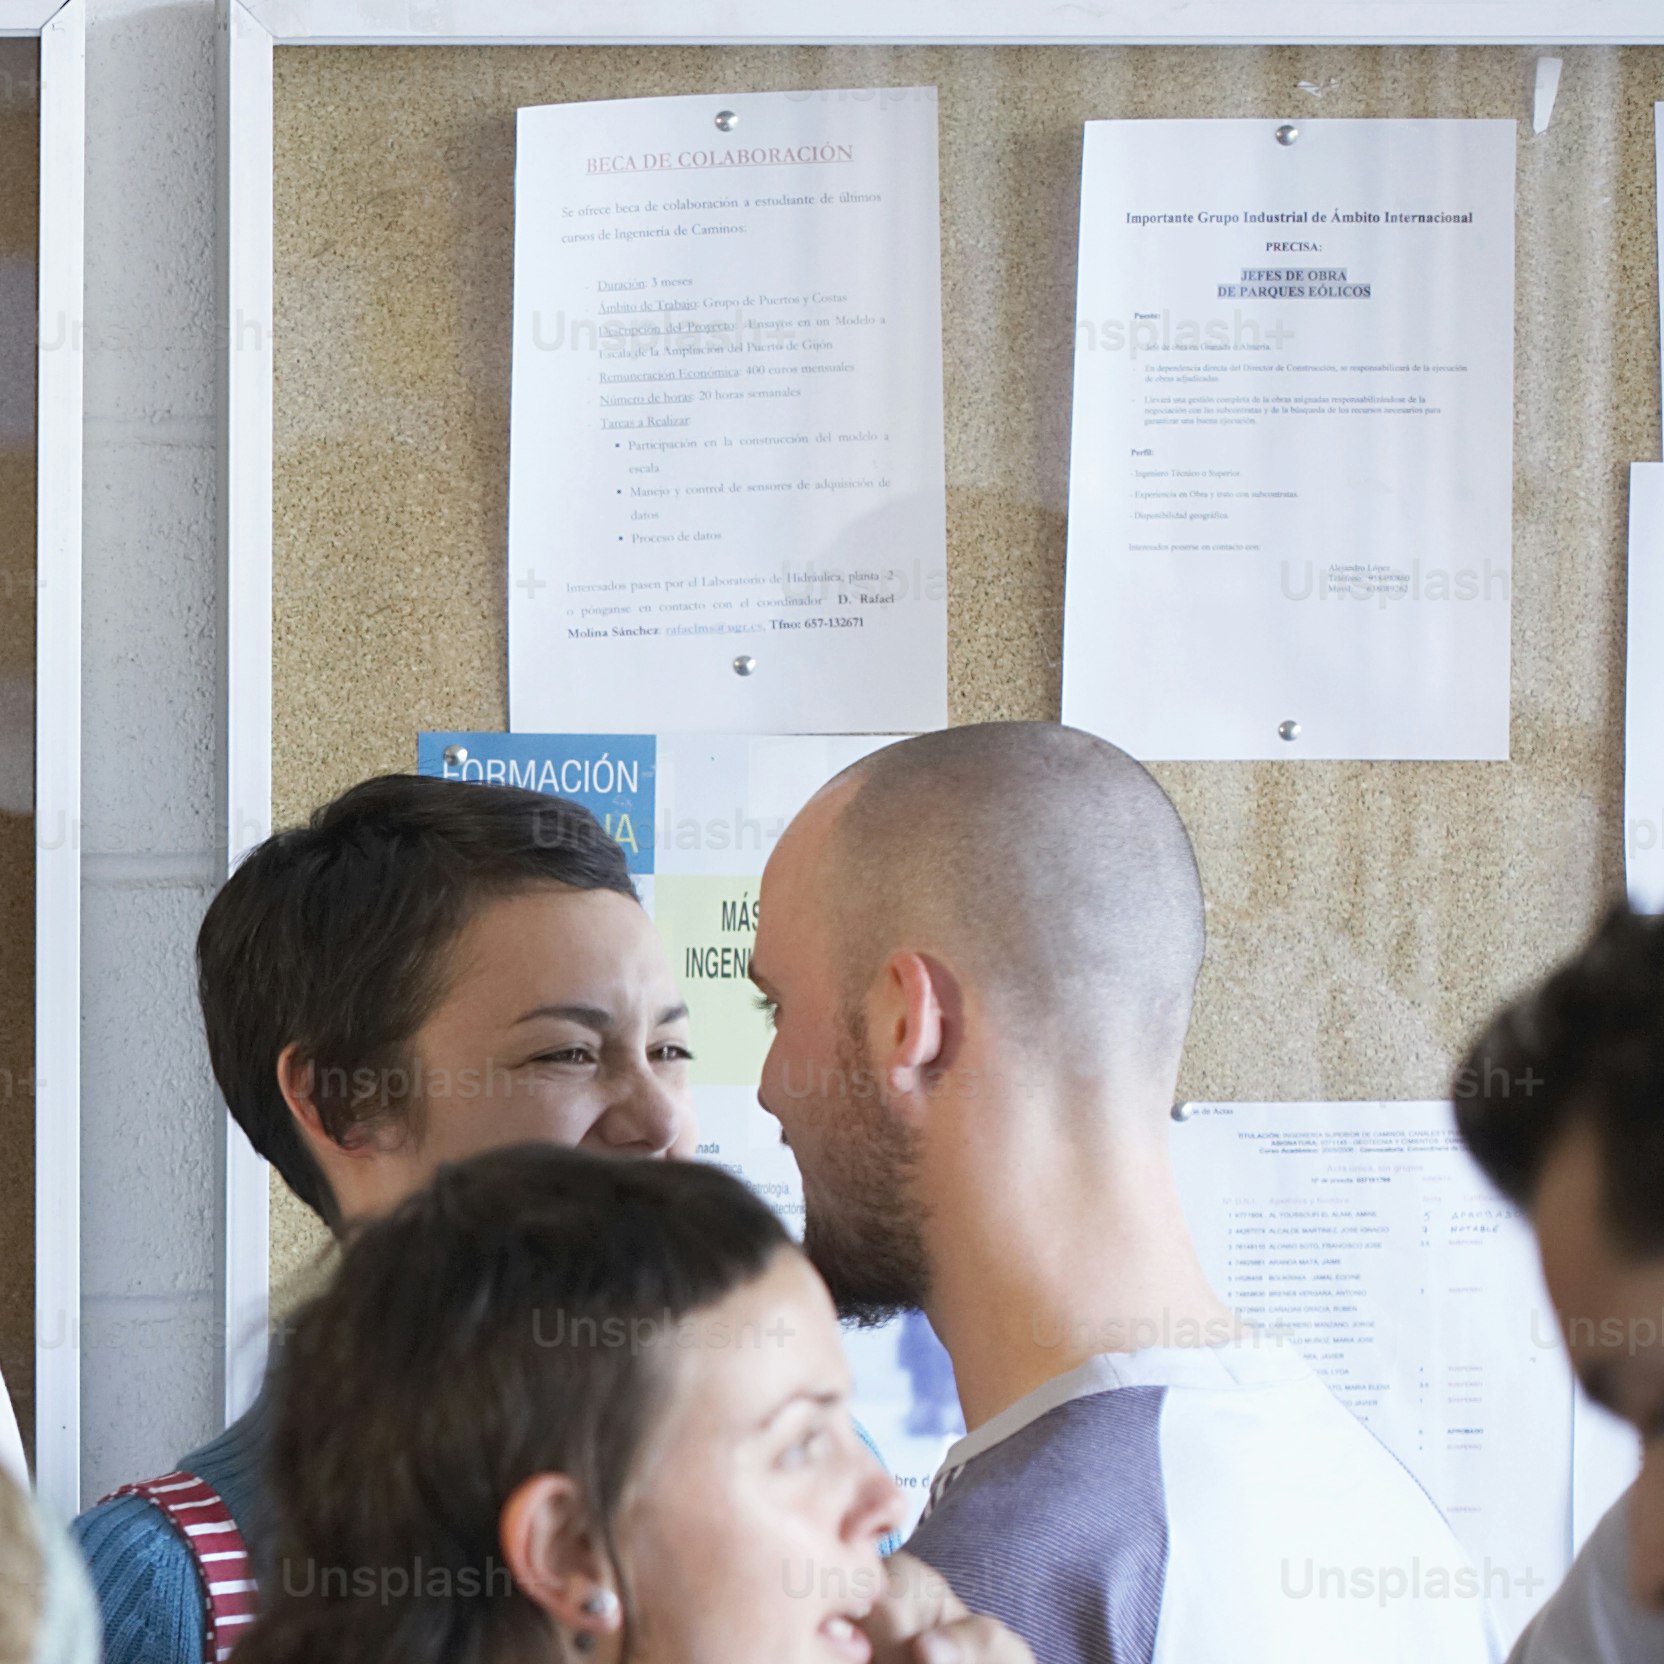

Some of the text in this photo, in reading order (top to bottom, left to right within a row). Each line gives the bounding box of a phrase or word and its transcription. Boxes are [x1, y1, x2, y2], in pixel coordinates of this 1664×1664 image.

[587, 140, 853, 176] BECA DE COLABORACIÓN
[1126, 207, 1473, 227] Importante Grupo Industrial de Ámbito Internacional
[1266, 241, 1322, 252] PRECISA:
[1241, 270, 1347, 282] JEFES DE OBRA
[1217, 283, 1371, 300] DE PARQUES EÓLICOS
[567, 627, 608, 640] Molina
